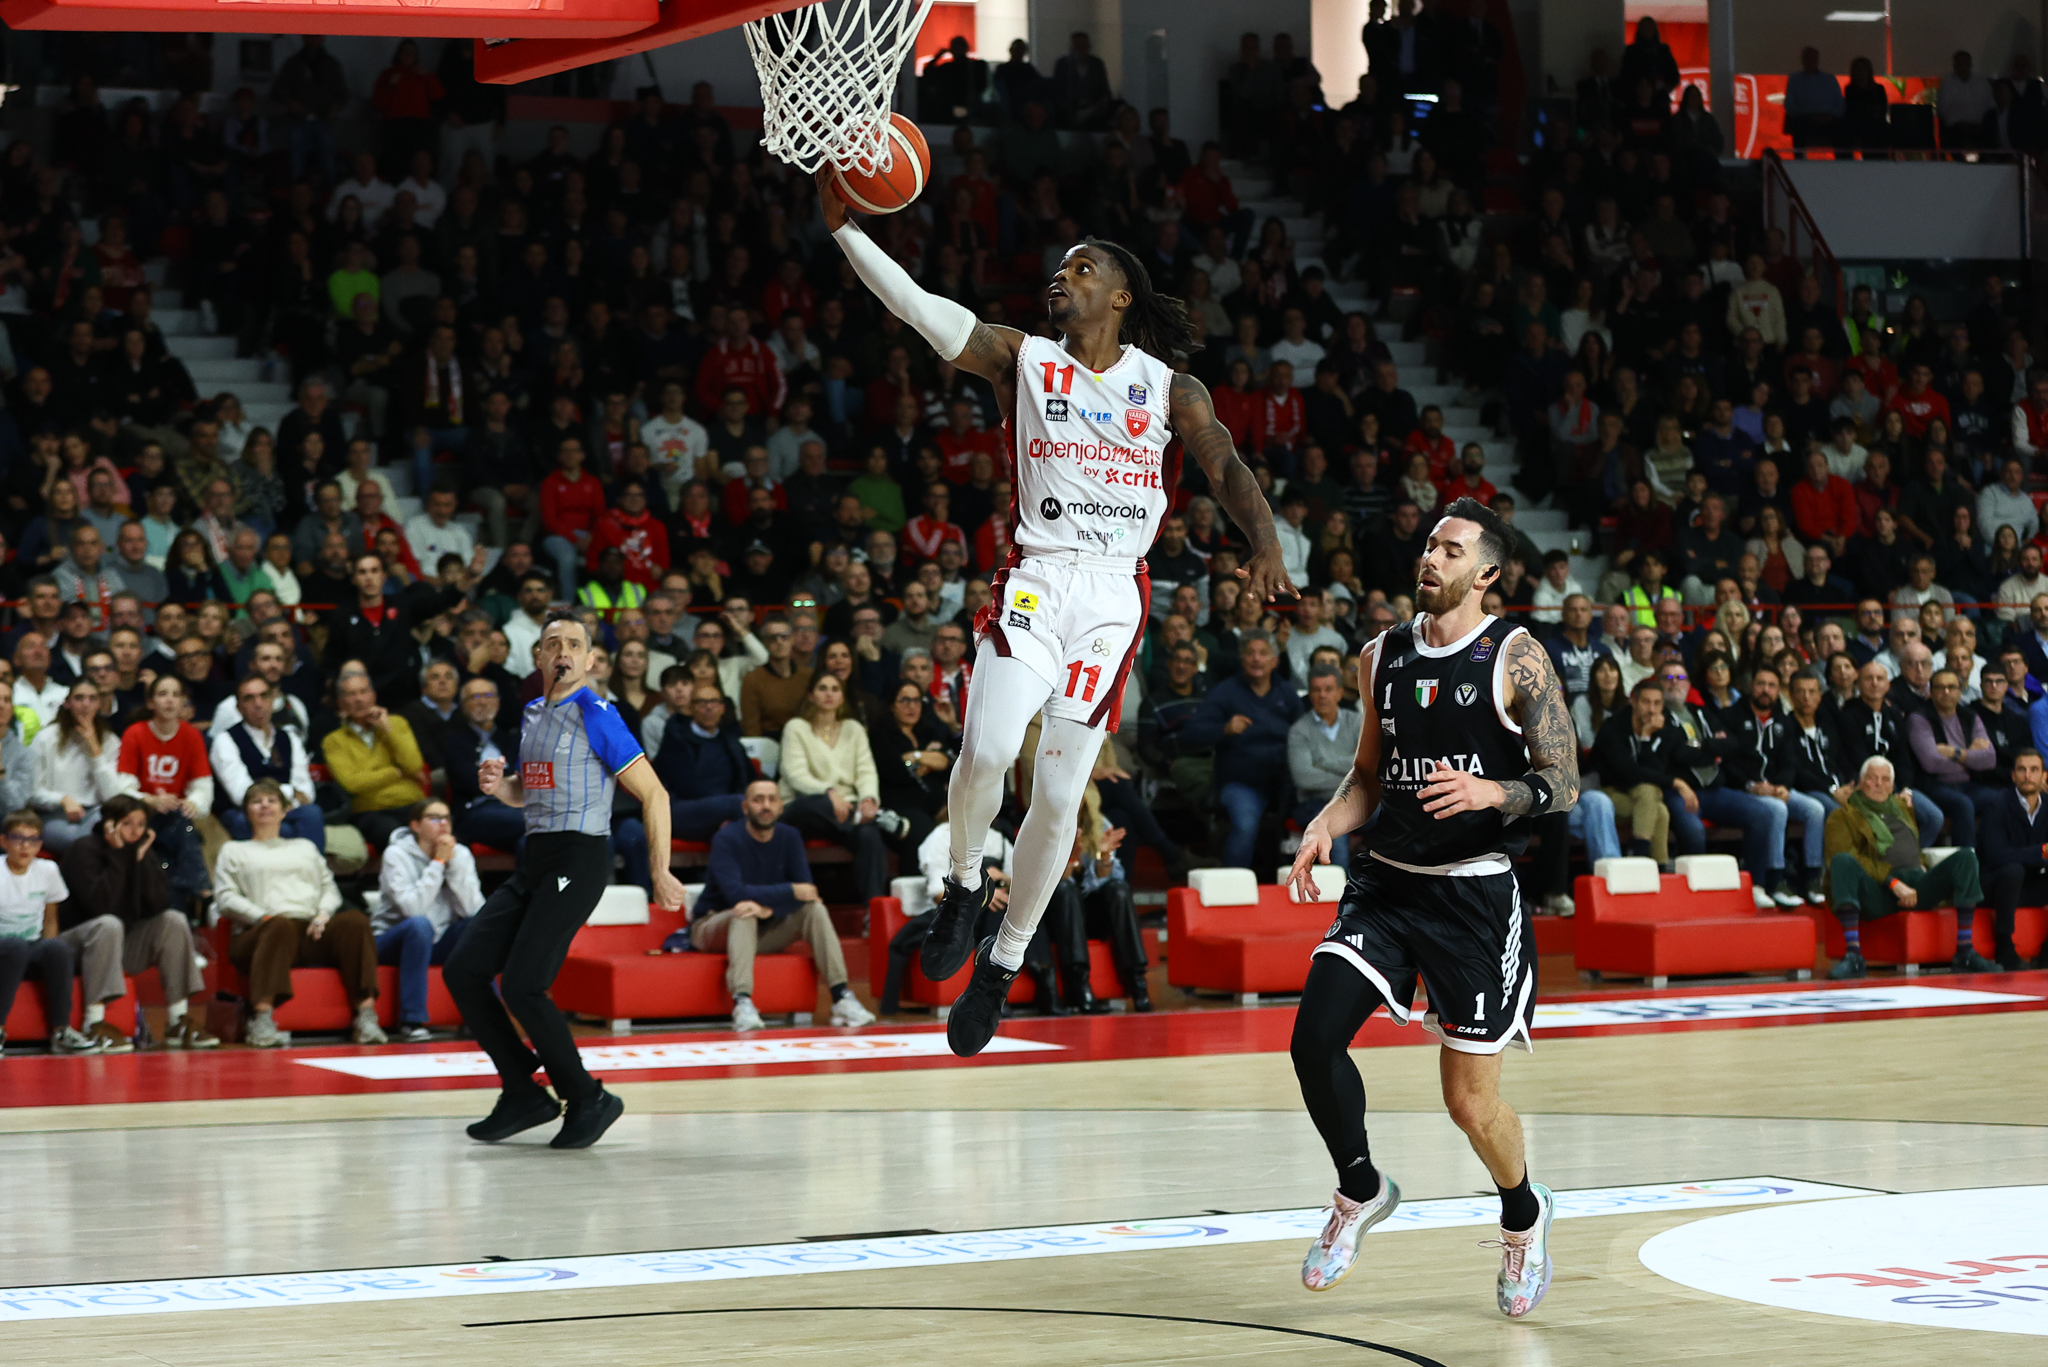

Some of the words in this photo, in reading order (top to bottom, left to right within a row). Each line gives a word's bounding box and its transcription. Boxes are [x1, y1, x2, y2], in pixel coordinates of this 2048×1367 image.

[1039, 361, 1074, 395] 11
[1128, 411, 1148, 421] VARESE
[1083, 466, 1100, 479] by
[1067, 502, 1147, 520] motorola
[1064, 659, 1102, 703] 11
[1383, 682, 1393, 709] 1
[147, 753, 180, 778] 10
[1473, 992, 1486, 1021] 1
